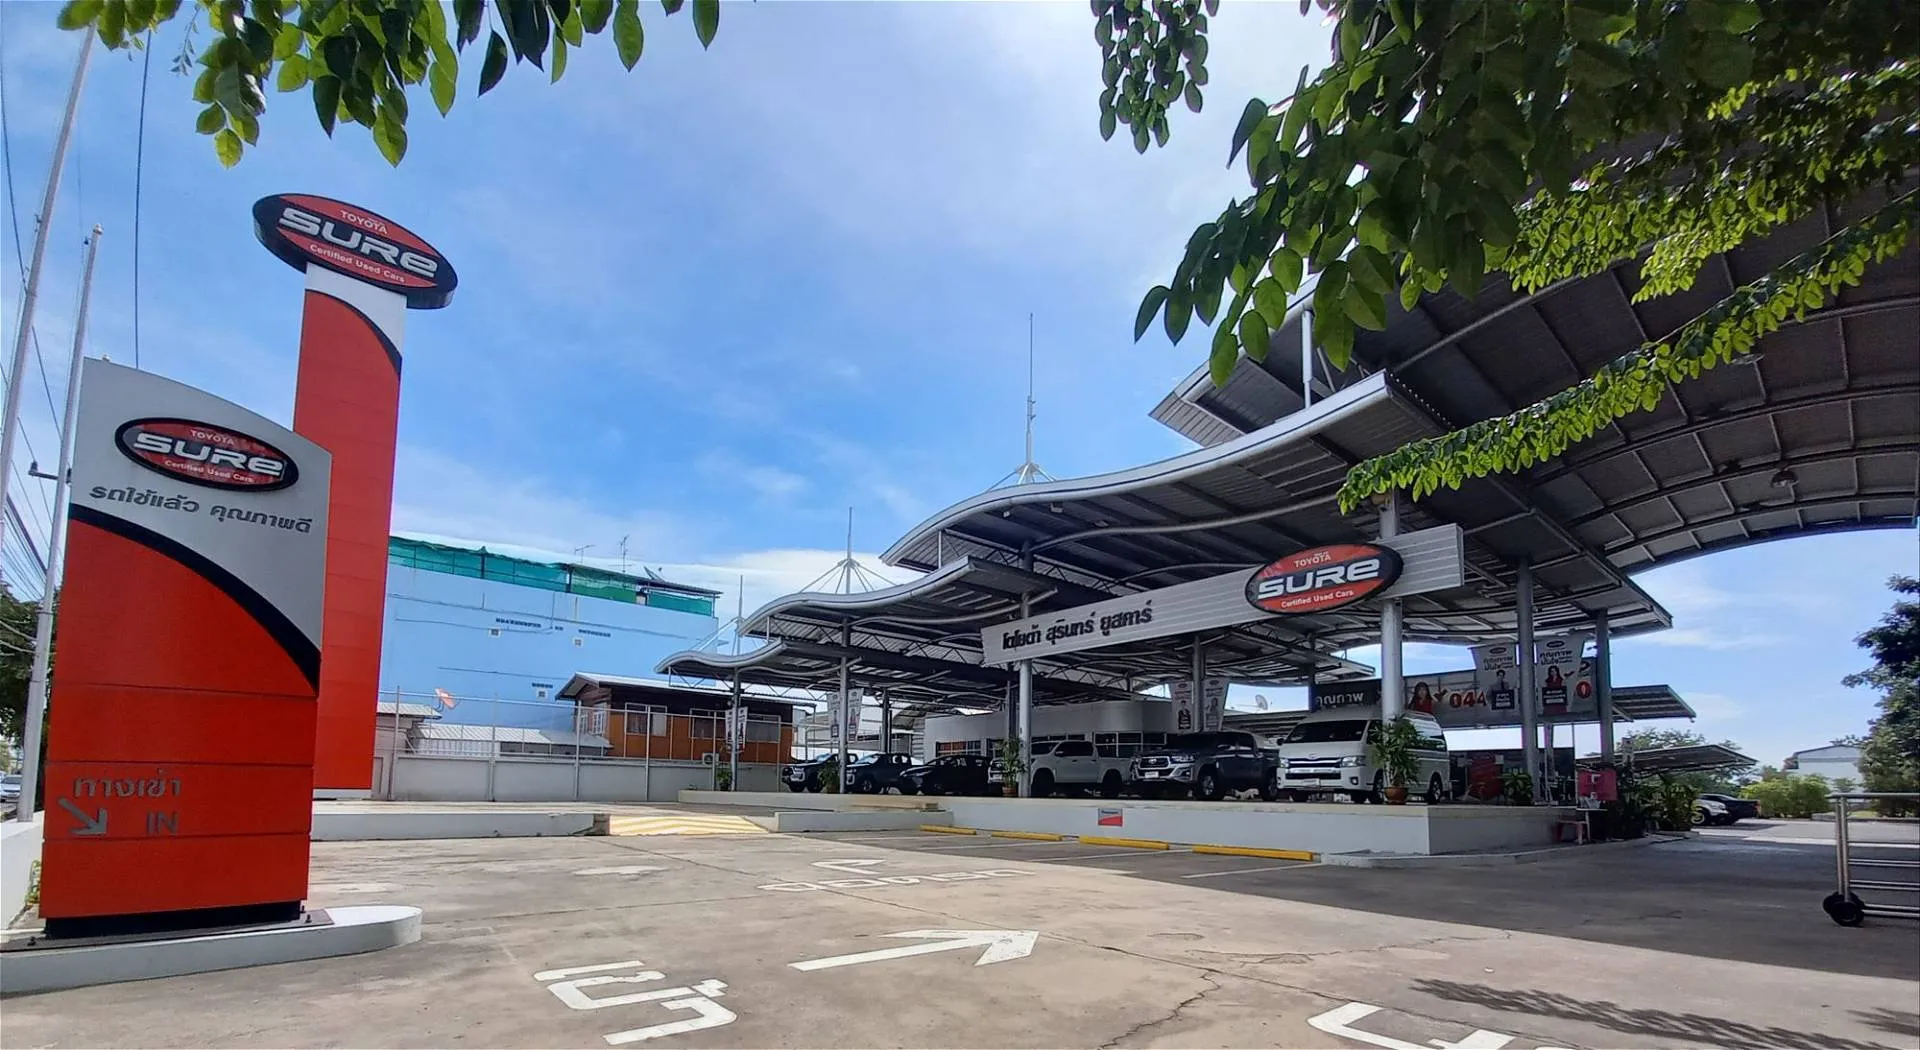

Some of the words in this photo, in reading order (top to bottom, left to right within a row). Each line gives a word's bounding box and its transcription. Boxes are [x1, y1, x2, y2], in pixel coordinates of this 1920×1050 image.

[340, 210, 388, 235] TOYOTA
[310, 244, 353, 265] Certified
[355, 259, 381, 275] Used
[383, 268, 405, 283] Cars
[190, 429, 236, 446] TOYOTA
[164, 459, 205, 474] Certified
[207, 467, 231, 479] Used
[233, 473, 254, 483] Cars
[89, 484, 200, 513] รถใช้แล้ว
[210, 504, 313, 534] คุณภาพดี
[1294, 553, 1332, 568] TOYOTA
[1281, 598, 1312, 609] Certified
[1313, 593, 1334, 602] Used
[1335, 590, 1354, 599] Cars
[1003, 624, 1042, 650] โตโยต้า
[1045, 611, 1096, 645] สุรินทร์
[74, 768, 182, 797] ทางเข้า
[147, 810, 179, 835] IN
